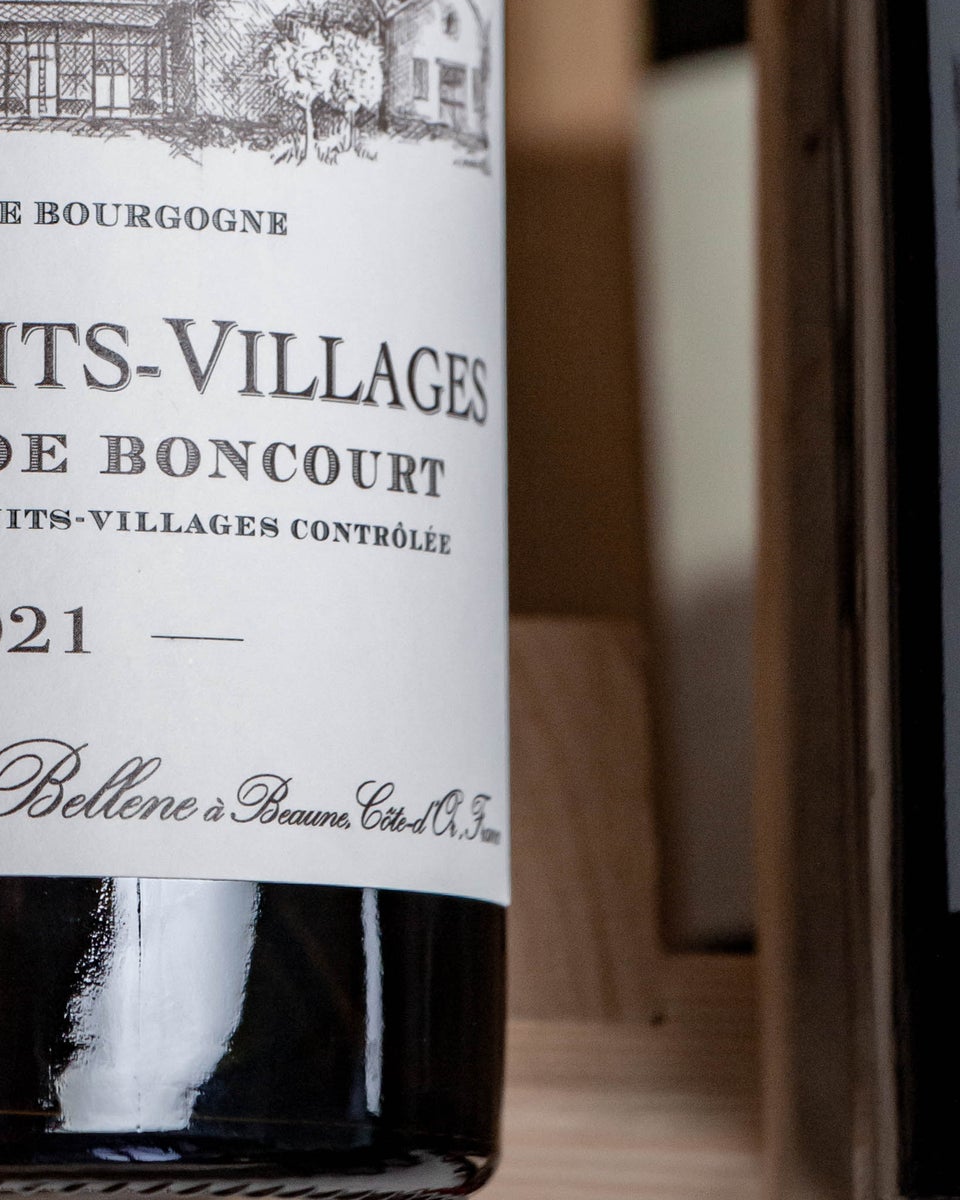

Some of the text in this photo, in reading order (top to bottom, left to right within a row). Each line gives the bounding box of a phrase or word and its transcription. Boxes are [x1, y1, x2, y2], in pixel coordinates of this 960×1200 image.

[33, 201, 288, 236] BOURGOGNE
[99, 434, 446, 498] BONCOURT
[290, 517, 452, 556] CONTRÔLÉE
[203, 797, 226, 822] à
[230, 773, 352, 830] Beaune,
